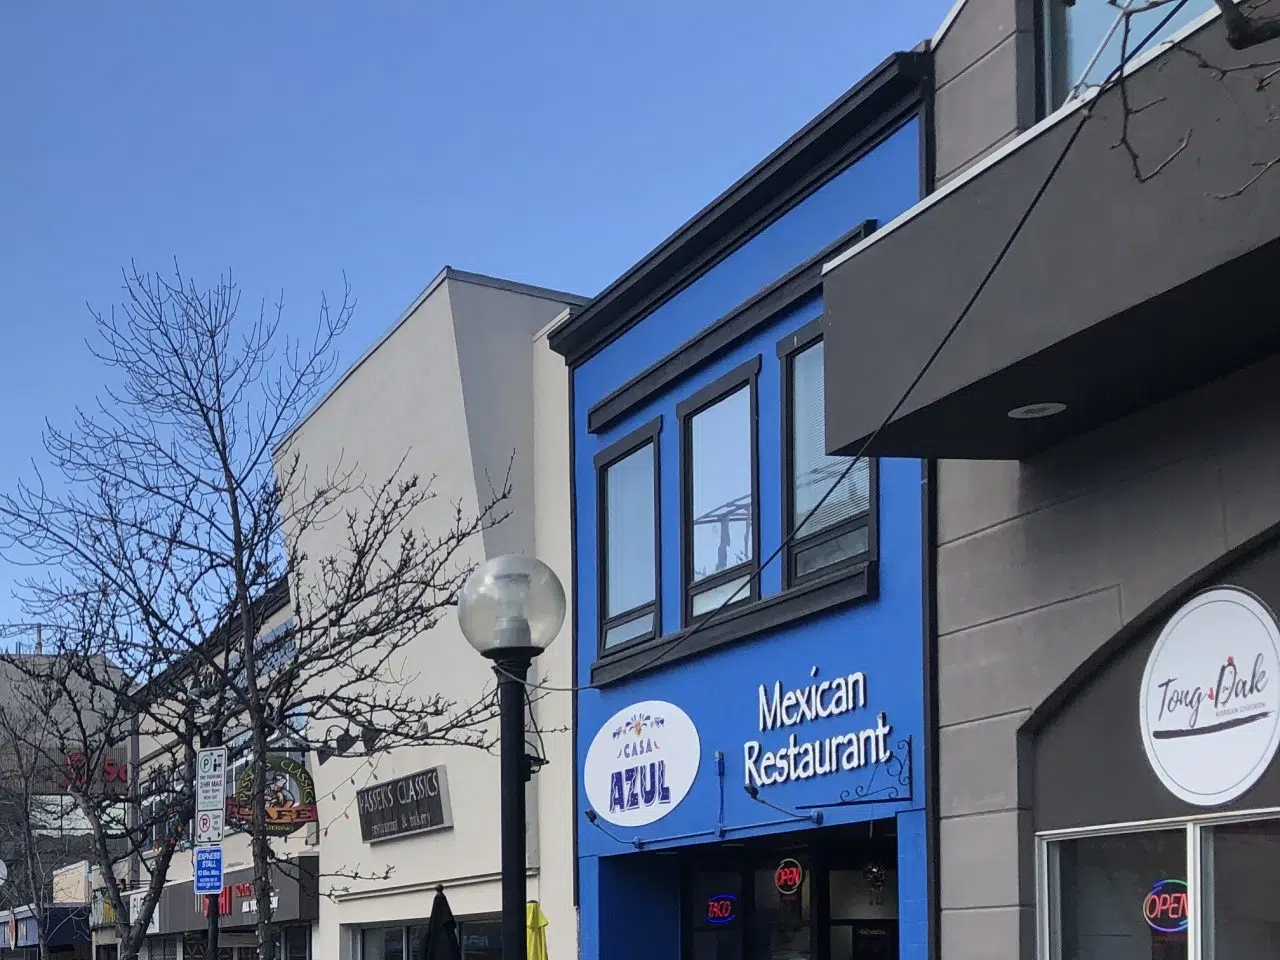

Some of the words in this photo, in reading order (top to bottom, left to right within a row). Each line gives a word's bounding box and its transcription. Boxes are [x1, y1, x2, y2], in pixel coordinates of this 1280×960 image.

[758, 665, 866, 732] Mexican
[1158, 677, 1206, 728] Tong
[1214, 652, 1267, 709] Dak
[623, 737, 653, 759] CASA
[743, 712, 891, 787] Restaurant
[280, 759, 314, 804] CLASSICS
[397, 772, 439, 805] CLASSICS
[609, 759, 671, 814] AZUL
[262, 806, 313, 822] AFE
[402, 814, 408, 828] &
[198, 851, 221, 860] EXPRESS
[201, 860, 217, 868] STALL
[776, 867, 801, 887] OPEN
[708, 901, 732, 918] TACO
[1146, 893, 1189, 919] OPEN
